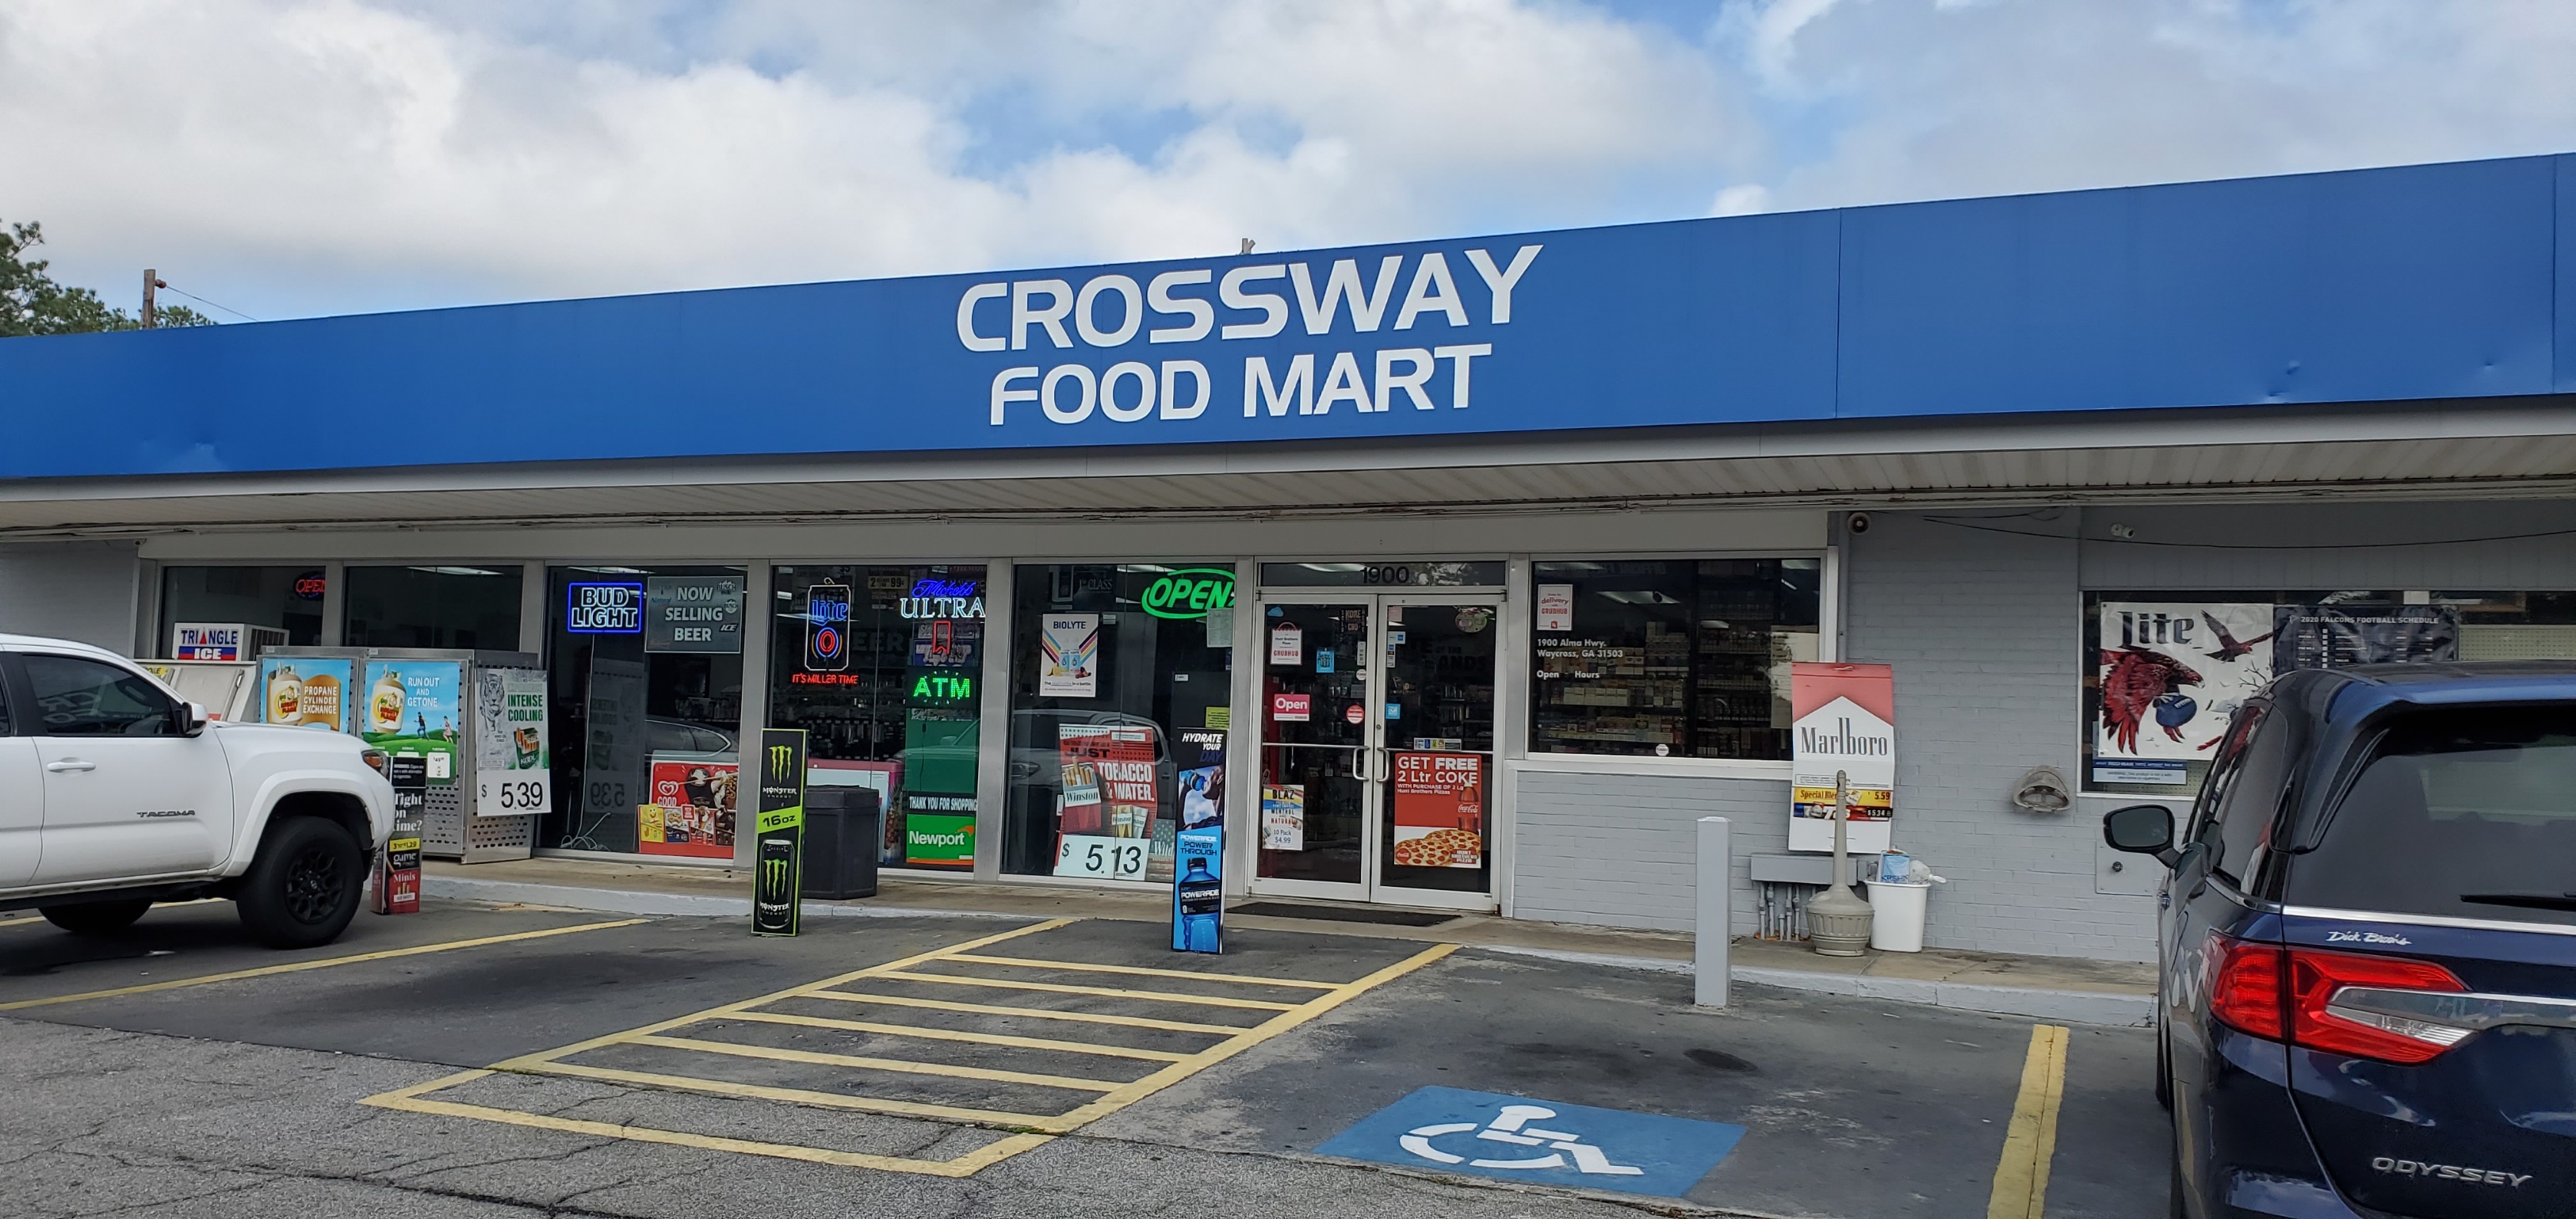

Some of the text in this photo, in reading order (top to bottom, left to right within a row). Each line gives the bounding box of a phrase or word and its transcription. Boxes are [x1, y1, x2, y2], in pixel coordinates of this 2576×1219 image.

[957, 245, 1543, 351] CROSSWAY
[991, 343, 1492, 426] FOOD MART
[1360, 566, 1409, 583] 1900
[717, 583, 736, 592] BUSCH
[1087, 579, 1113, 590] CLASS
[581, 587, 629, 607] BUD
[677, 587, 713, 601] NOW
[1148, 577, 1234, 610] OPEN
[900, 596, 986, 619] ULTRA
[1542, 597, 1569, 606] delivery
[571, 607, 637, 628] LIGHT
[665, 607, 723, 621] SELLING
[1053, 621, 1087, 629] BIOLYTE
[675, 628, 712, 641] BEER
[1584, 639, 1607, 648] Hwy.
[194, 648, 222, 659] ICE
[1537, 649, 1579, 659] Waycross,
[792, 673, 858, 685] IT'S MILLER TIME
[1537, 670, 1559, 680] Open
[407, 677, 440, 687] RUN OUT
[912, 677, 971, 698] ATM
[304, 686, 338, 696] PROPANE
[304, 696, 337, 705] CYLINDER
[407, 697, 438, 707] GET ONE
[507, 694, 543, 707] INTENSE
[1275, 697, 1308, 712] Open
[303, 705, 337, 714] EXCHANGE
[508, 709, 544, 722] COOLING
[1182, 732, 1224, 744] HYDRATE
[1800, 716, 1888, 756] Marlboro
[1064, 747, 1110, 758] JUST
[1202, 743, 1221, 751] YOUR
[520, 754, 537, 765] KOOL
[1199, 751, 1223, 762] DAY
[1397, 755, 1478, 770] GET FREE
[1097, 762, 1152, 782] TOBACCO
[1397, 770, 1477, 784] 2 Ltr COKE
[481, 781, 543, 810] $ 5.39
[762, 786, 797, 795] MONSTER
[1114, 782, 1155, 801] WATER.
[1272, 788, 1295, 800] BLAZ
[1800, 789, 1823, 800] Special
[1875, 791, 1890, 801] 5.59
[395, 793, 423, 808] Tight
[657, 796, 678, 807] GOOD
[1064, 791, 1099, 803] Winston
[909, 797, 977, 812] THANK YOU FOR SHOPPING
[394, 820, 422, 831] ime?
[909, 831, 965, 847] Newport
[1154, 841, 1174, 856] Wild
[393, 853, 416, 867] game
[1061, 843, 1141, 873] $ 5.13
[393, 872, 416, 883] Minis
[1181, 889, 1219, 899] POWERADE
[760, 901, 789, 911] MONSTER
[2326, 930, 2362, 942] Dick
[2372, 1157, 2533, 1187] ODYSSEY
